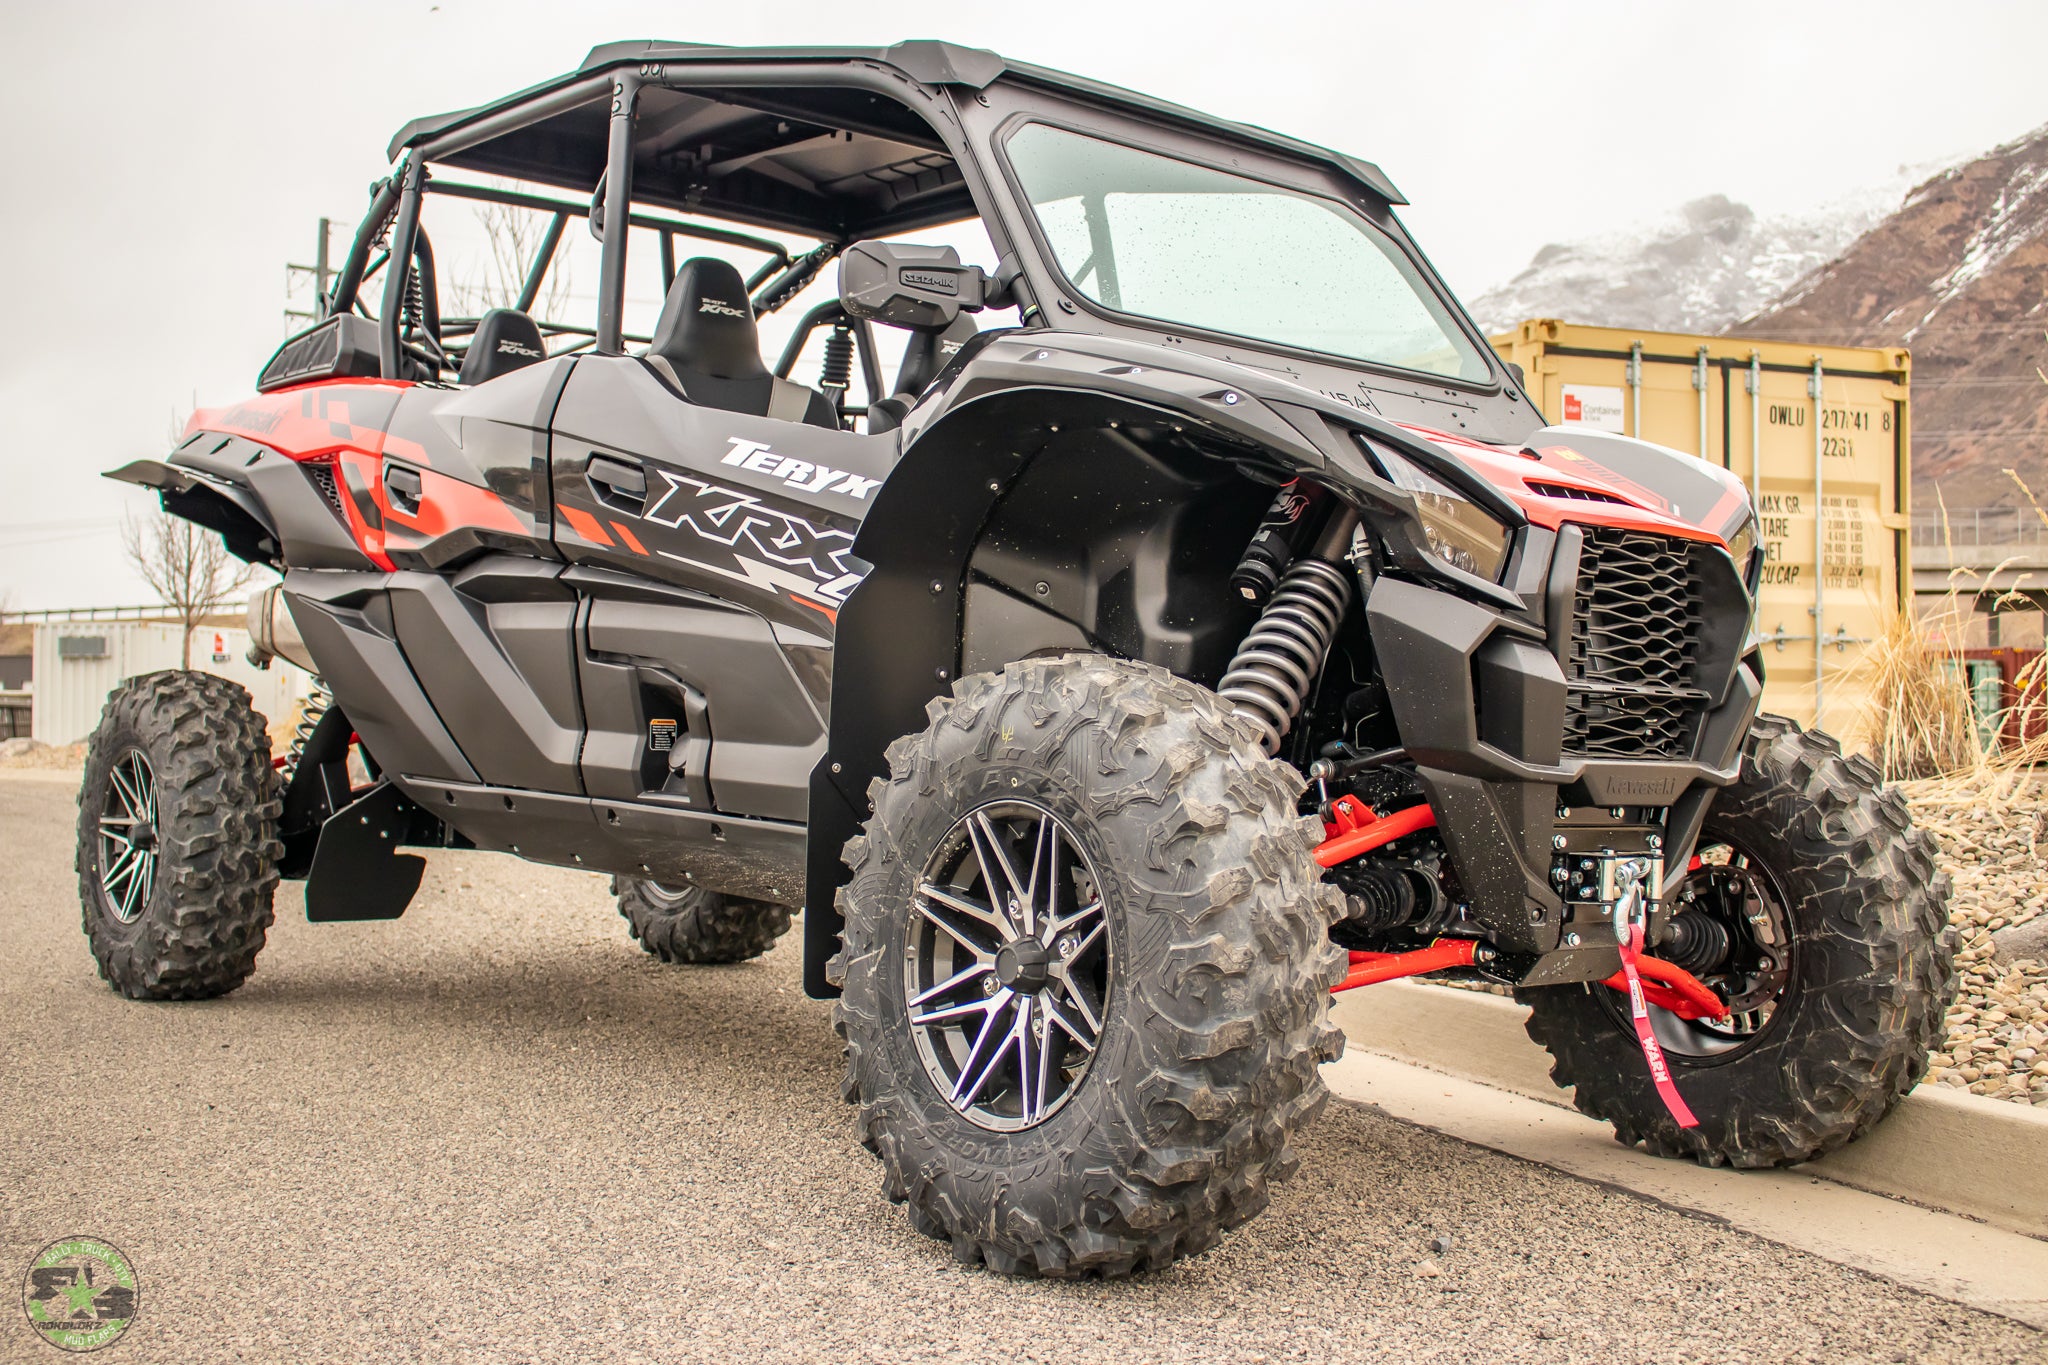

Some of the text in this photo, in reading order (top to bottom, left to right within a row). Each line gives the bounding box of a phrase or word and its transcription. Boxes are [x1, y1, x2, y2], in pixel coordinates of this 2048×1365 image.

[904, 273, 954, 289] SEIZMIK
[699, 303, 745, 318] KRX
[497, 345, 541, 358] KRX
[1583, 403, 1622, 416] Container
[1769, 405, 1804, 426] OWLU
[1882, 411, 1890, 431] 8
[720, 436, 884, 500] TERYX
[643, 469, 857, 581] KRX
[1762, 517, 1789, 537] TARE
[1642, 1036, 1669, 1083] WARN
